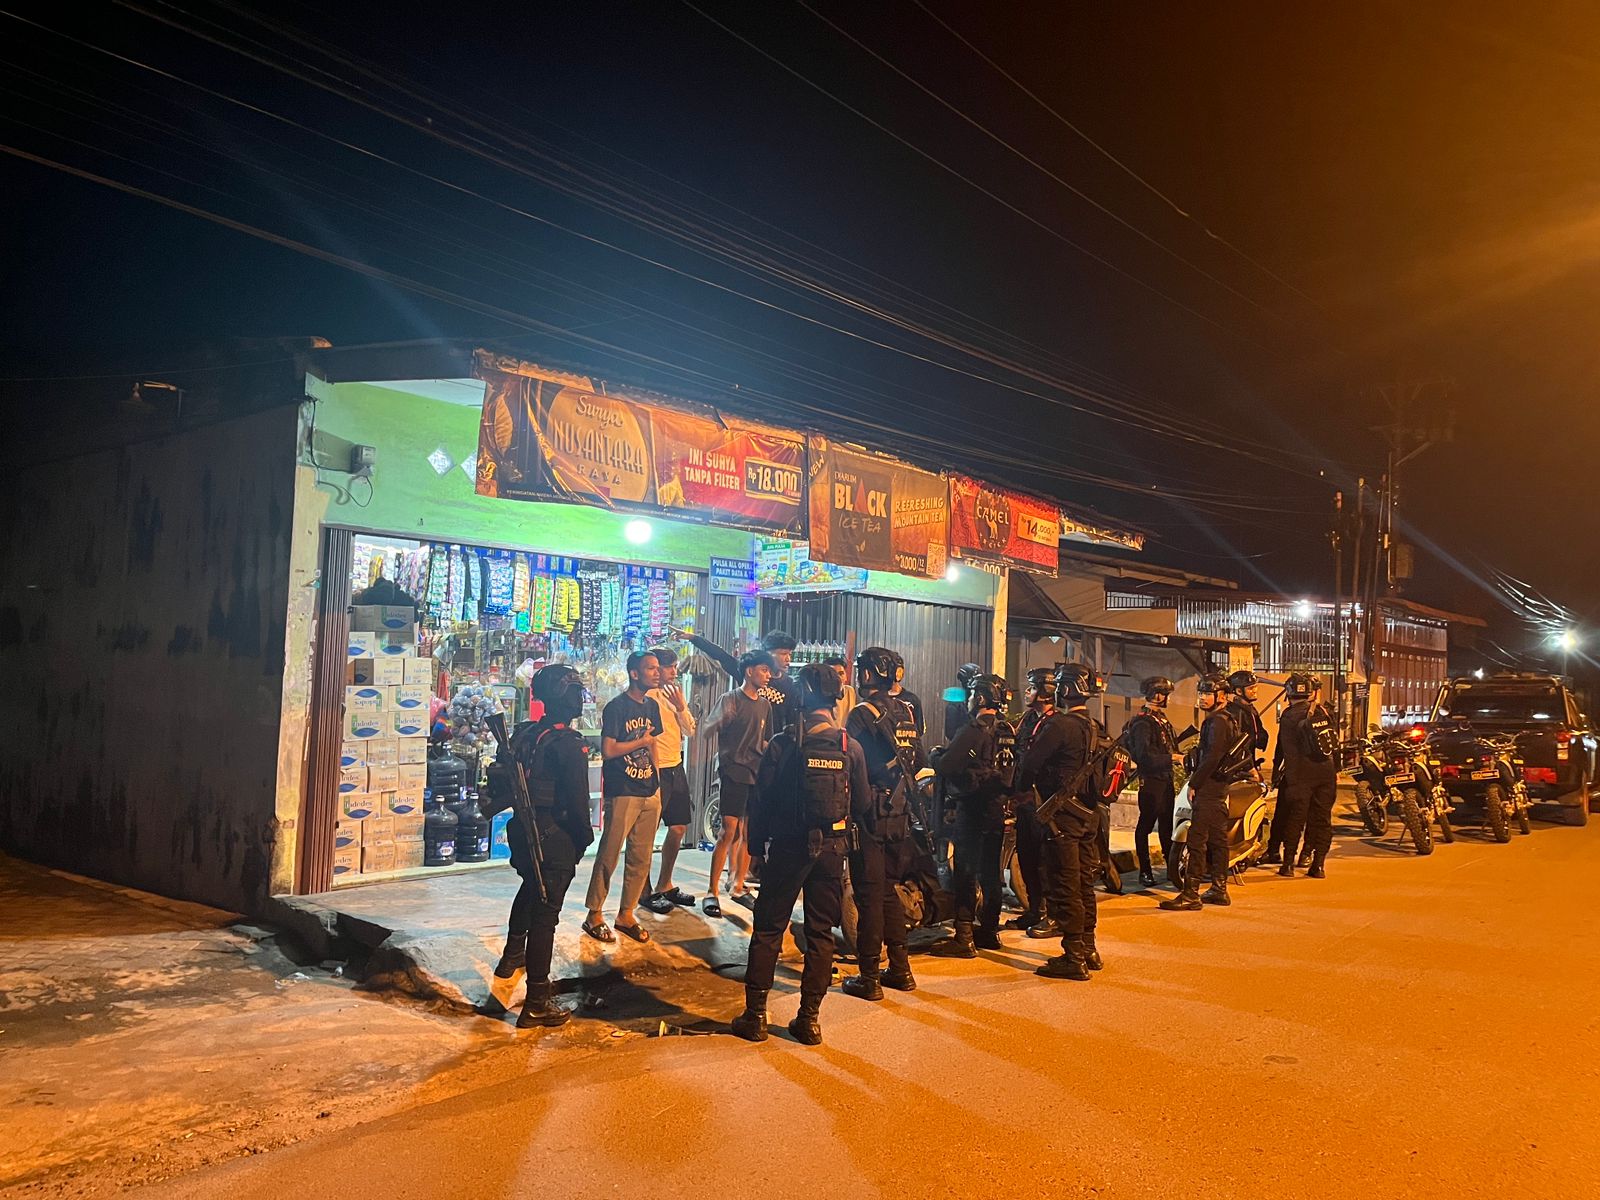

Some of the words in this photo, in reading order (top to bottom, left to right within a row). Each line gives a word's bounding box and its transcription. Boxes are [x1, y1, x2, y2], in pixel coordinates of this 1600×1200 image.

[576, 395, 623, 430] Surya
[553, 418, 644, 475] NUSANTARA
[689, 447, 703, 466] INI
[706, 451, 736, 473] SURYA
[576, 464, 621, 485] RAYA
[685, 466, 711, 485] TANPA
[714, 472, 740, 491] FILTER
[748, 467, 756, 483] Rp
[757, 466, 798, 493] 18.000
[834, 479, 887, 518] BLACK
[895, 497, 944, 513] REFRESHING
[839, 513, 858, 529] ICE
[862, 517, 881, 533] TEA
[894, 512, 929, 529] MOUNTAIN
[932, 511, 944, 524] TEA
[976, 505, 1009, 525] CAMEL
[712, 559, 727, 567] PULSA
[731, 569, 743, 577] DATA
[1312, 720, 1329, 728] POLISI
[807, 758, 843, 769] BRIMOB
